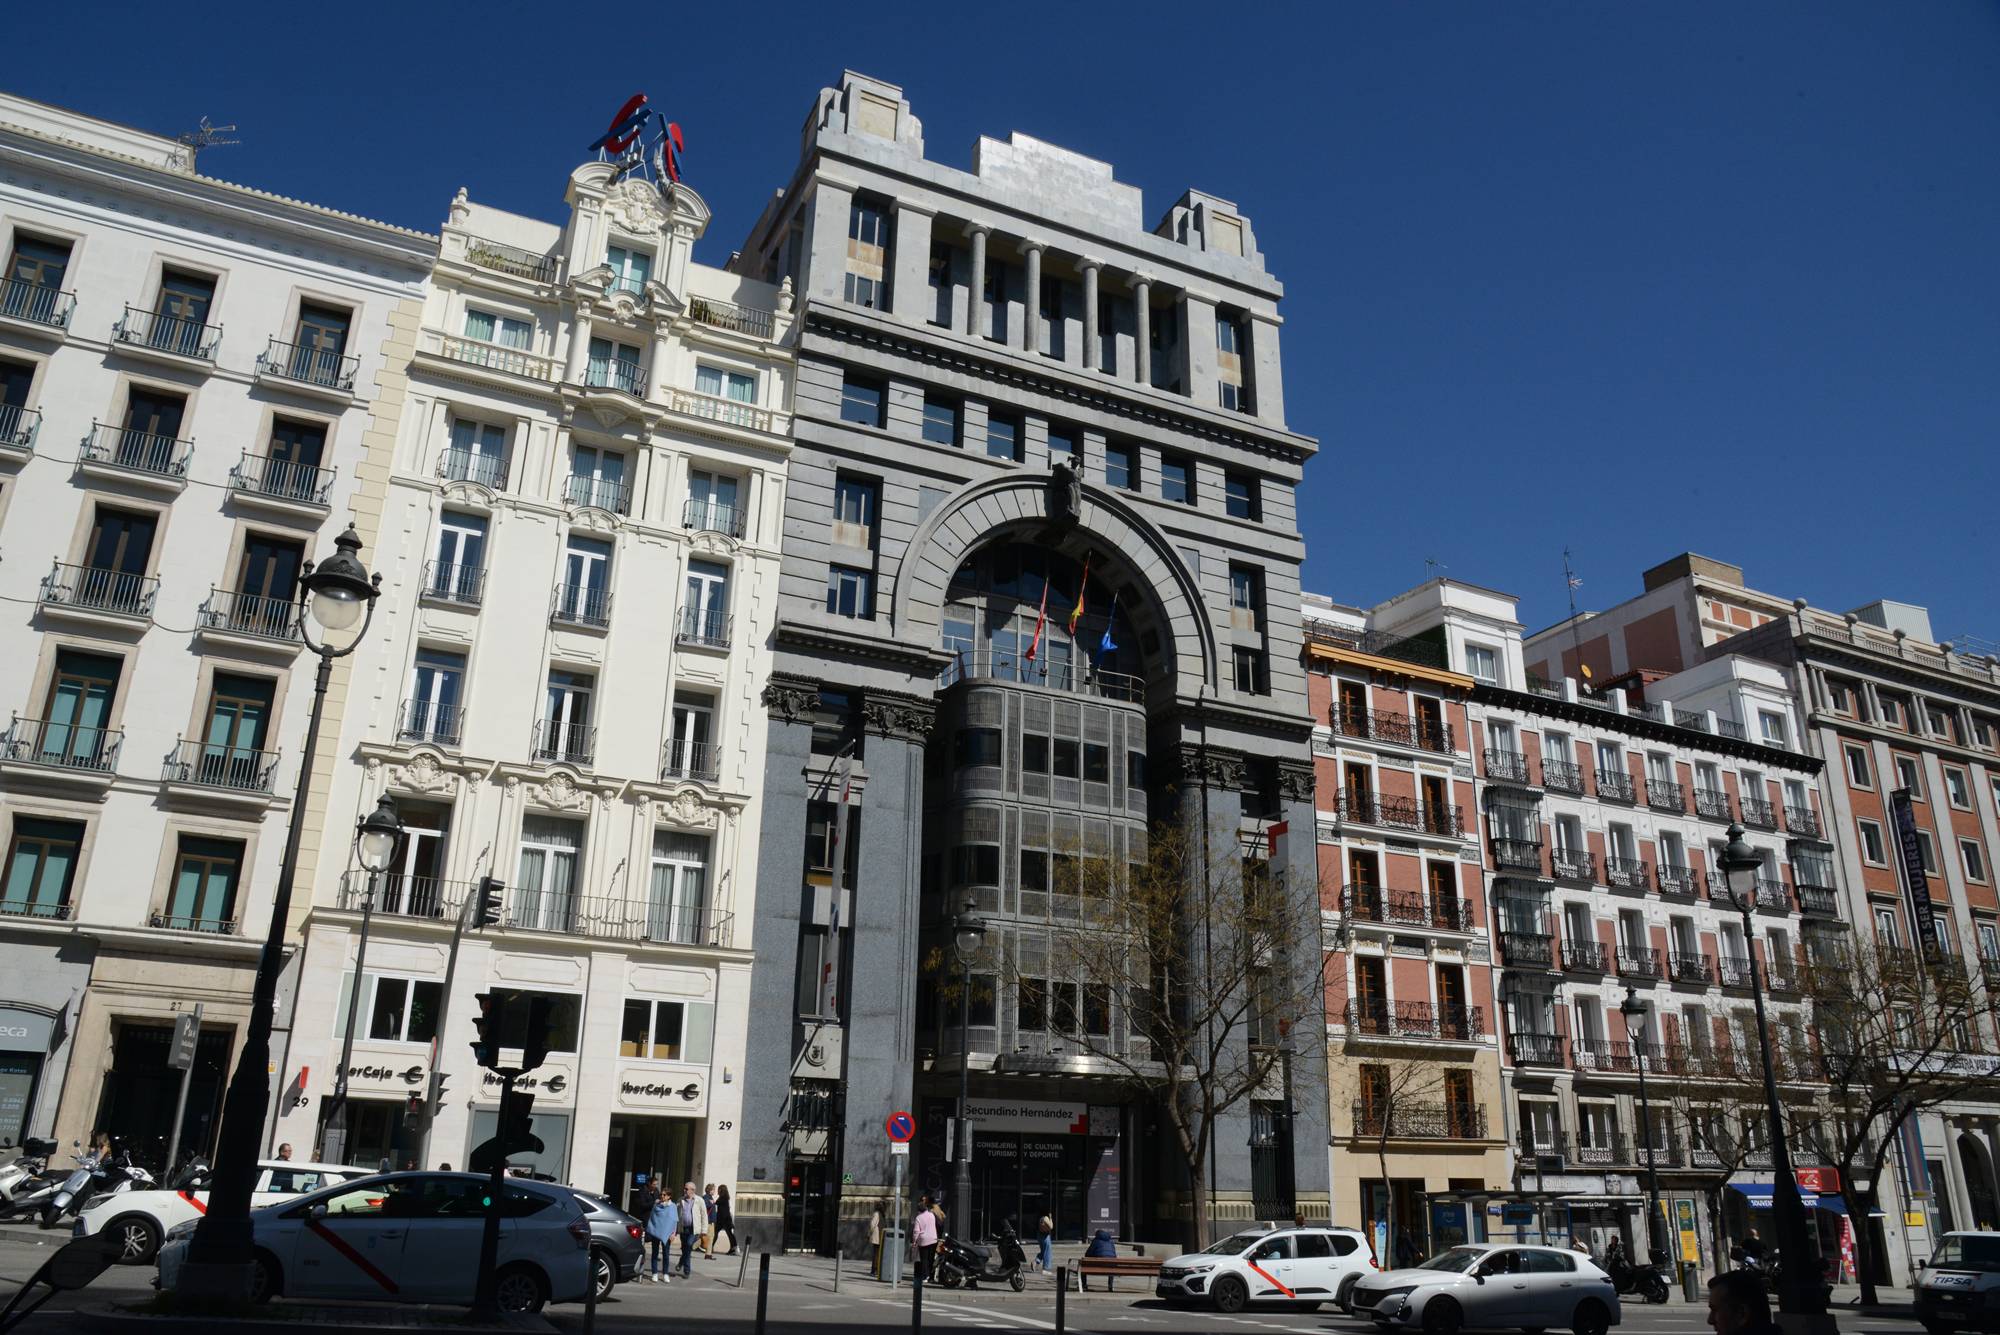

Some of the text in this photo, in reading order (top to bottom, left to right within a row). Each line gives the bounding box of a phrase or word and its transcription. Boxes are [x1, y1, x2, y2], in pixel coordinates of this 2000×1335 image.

[1904, 833, 1928, 903] MUJERES
[1919, 904, 1933, 930] SER
[169, 1001, 183, 1012] 27
[335, 1063, 393, 1082] ierCaja
[483, 1072, 538, 1090] ibeaja
[292, 1096, 309, 1108] 29
[965, 1104, 1074, 1119] Secundino Hernández
[718, 1120, 733, 1131] 29
[1023, 1142, 1032, 1150] DE
[1034, 1143, 1064, 1151] CULTURA
[987, 1150, 1017, 1158] TURISMO
[1029, 1151, 1059, 1159] DEPORTE
[1934, 1276, 1973, 1286] TIPSA
